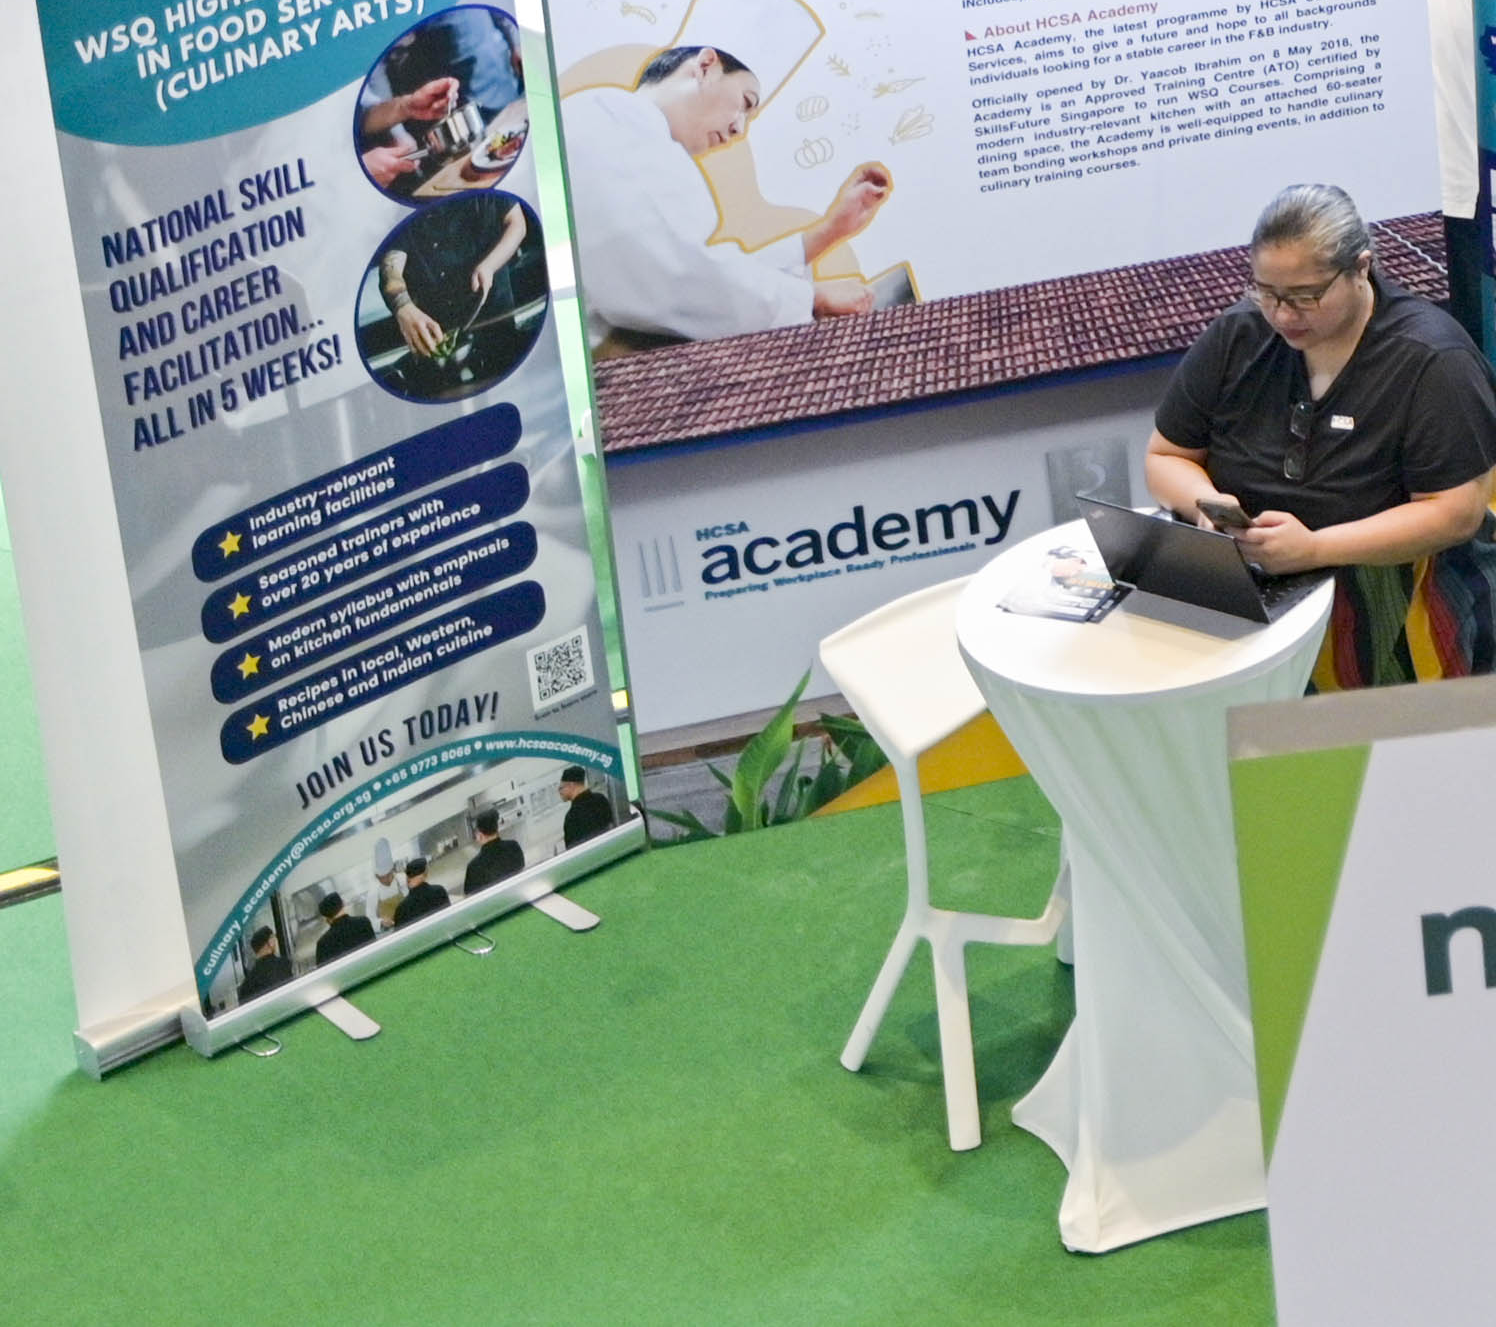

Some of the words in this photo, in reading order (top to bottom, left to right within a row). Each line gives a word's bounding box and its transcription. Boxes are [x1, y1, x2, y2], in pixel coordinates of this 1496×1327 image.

[74, 15, 157, 65] WSQ
[296, 751, 355, 810] JOIN
[359, 728, 397, 765] US
[402, 690, 501, 747] TODAY!
